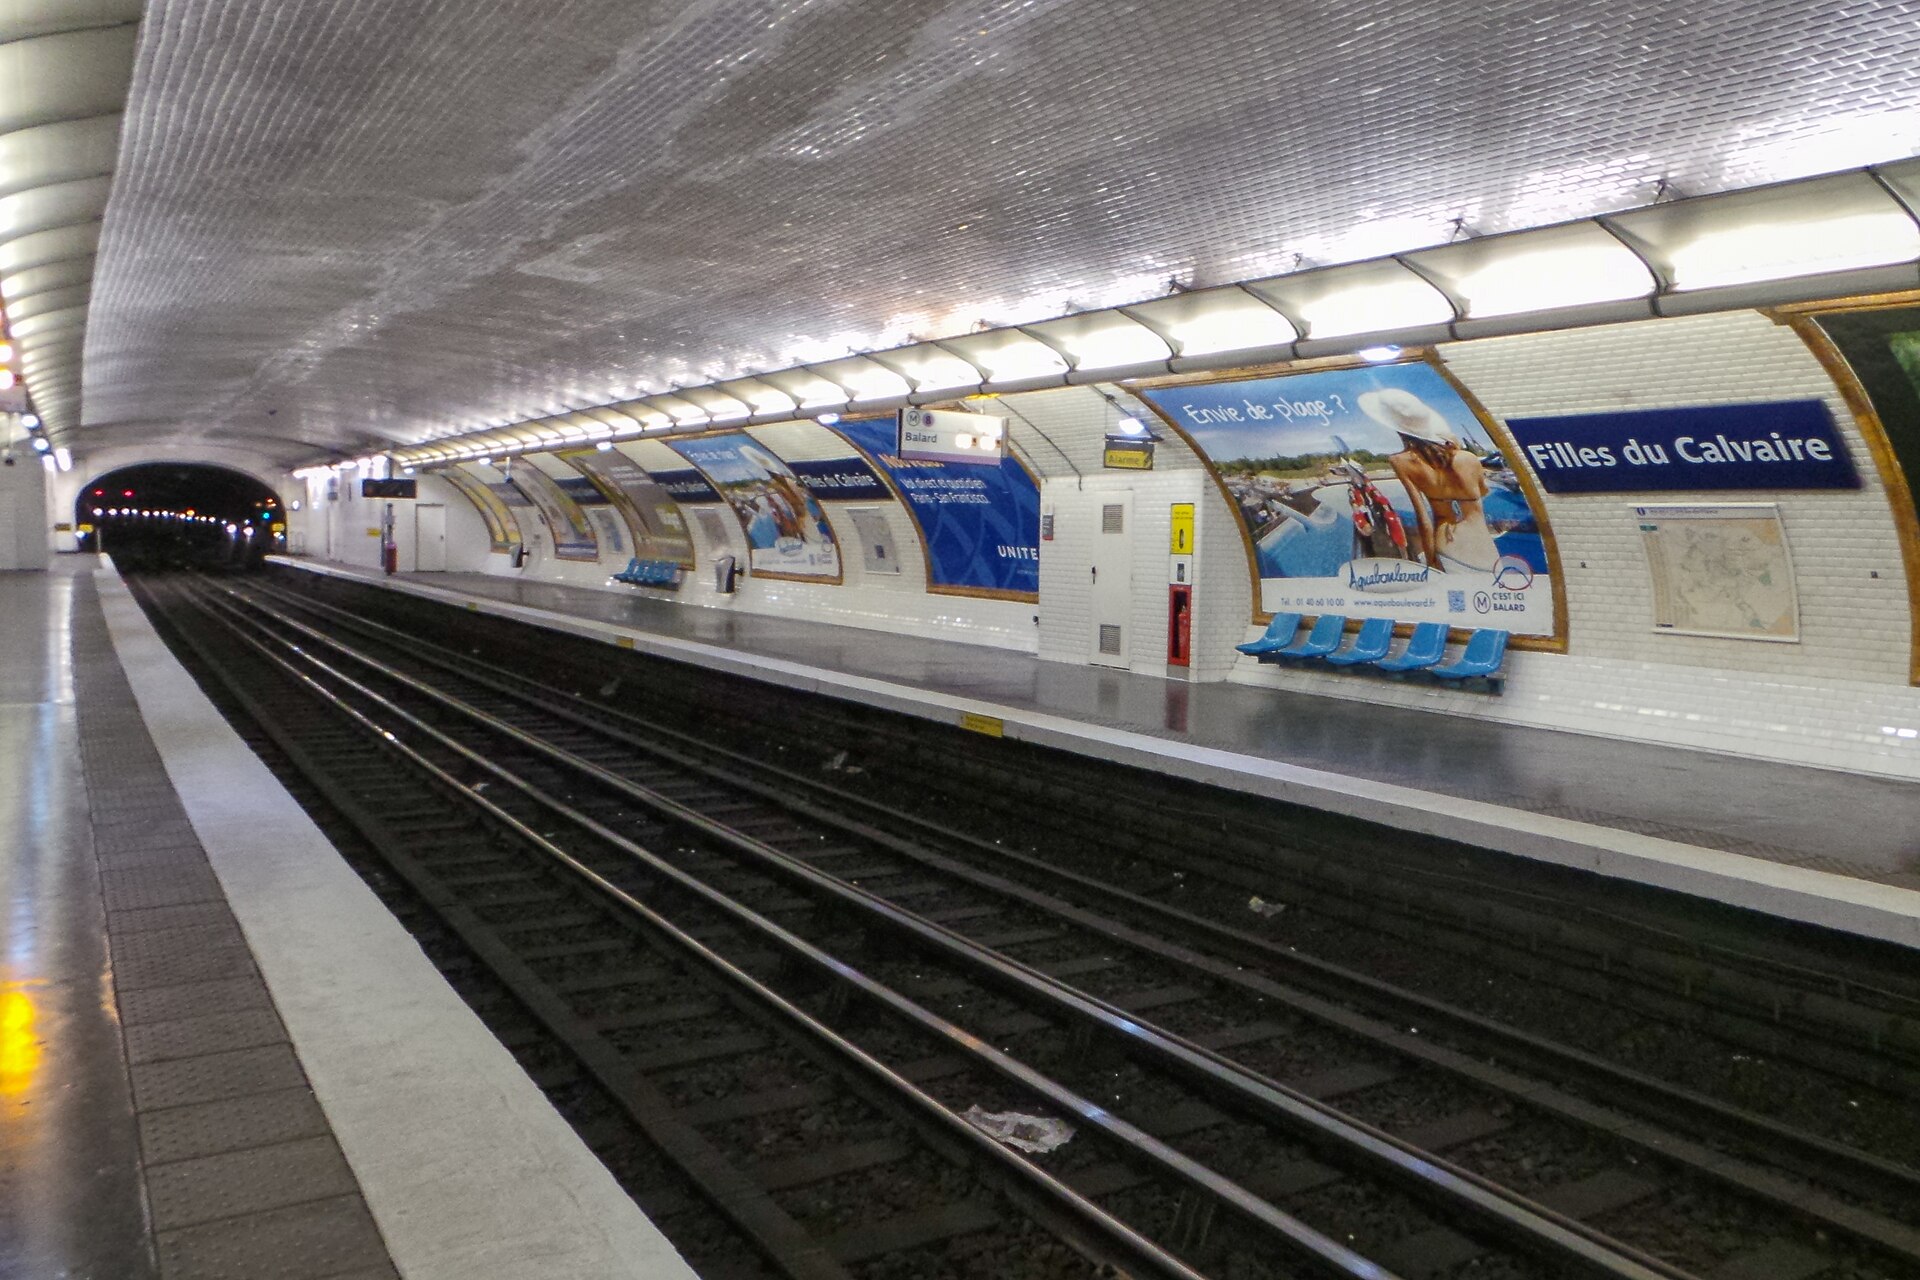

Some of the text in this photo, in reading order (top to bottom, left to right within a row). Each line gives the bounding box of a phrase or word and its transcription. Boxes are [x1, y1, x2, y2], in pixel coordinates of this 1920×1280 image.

[1182, 394, 1349, 427] Envie de plage ?
[905, 431, 937, 444] Balard
[1527, 432, 1833, 470] Filles du Calvaire
[1350, 561, 1428, 591] Aquaboulevard
[1493, 603, 1526, 612] BALARD
